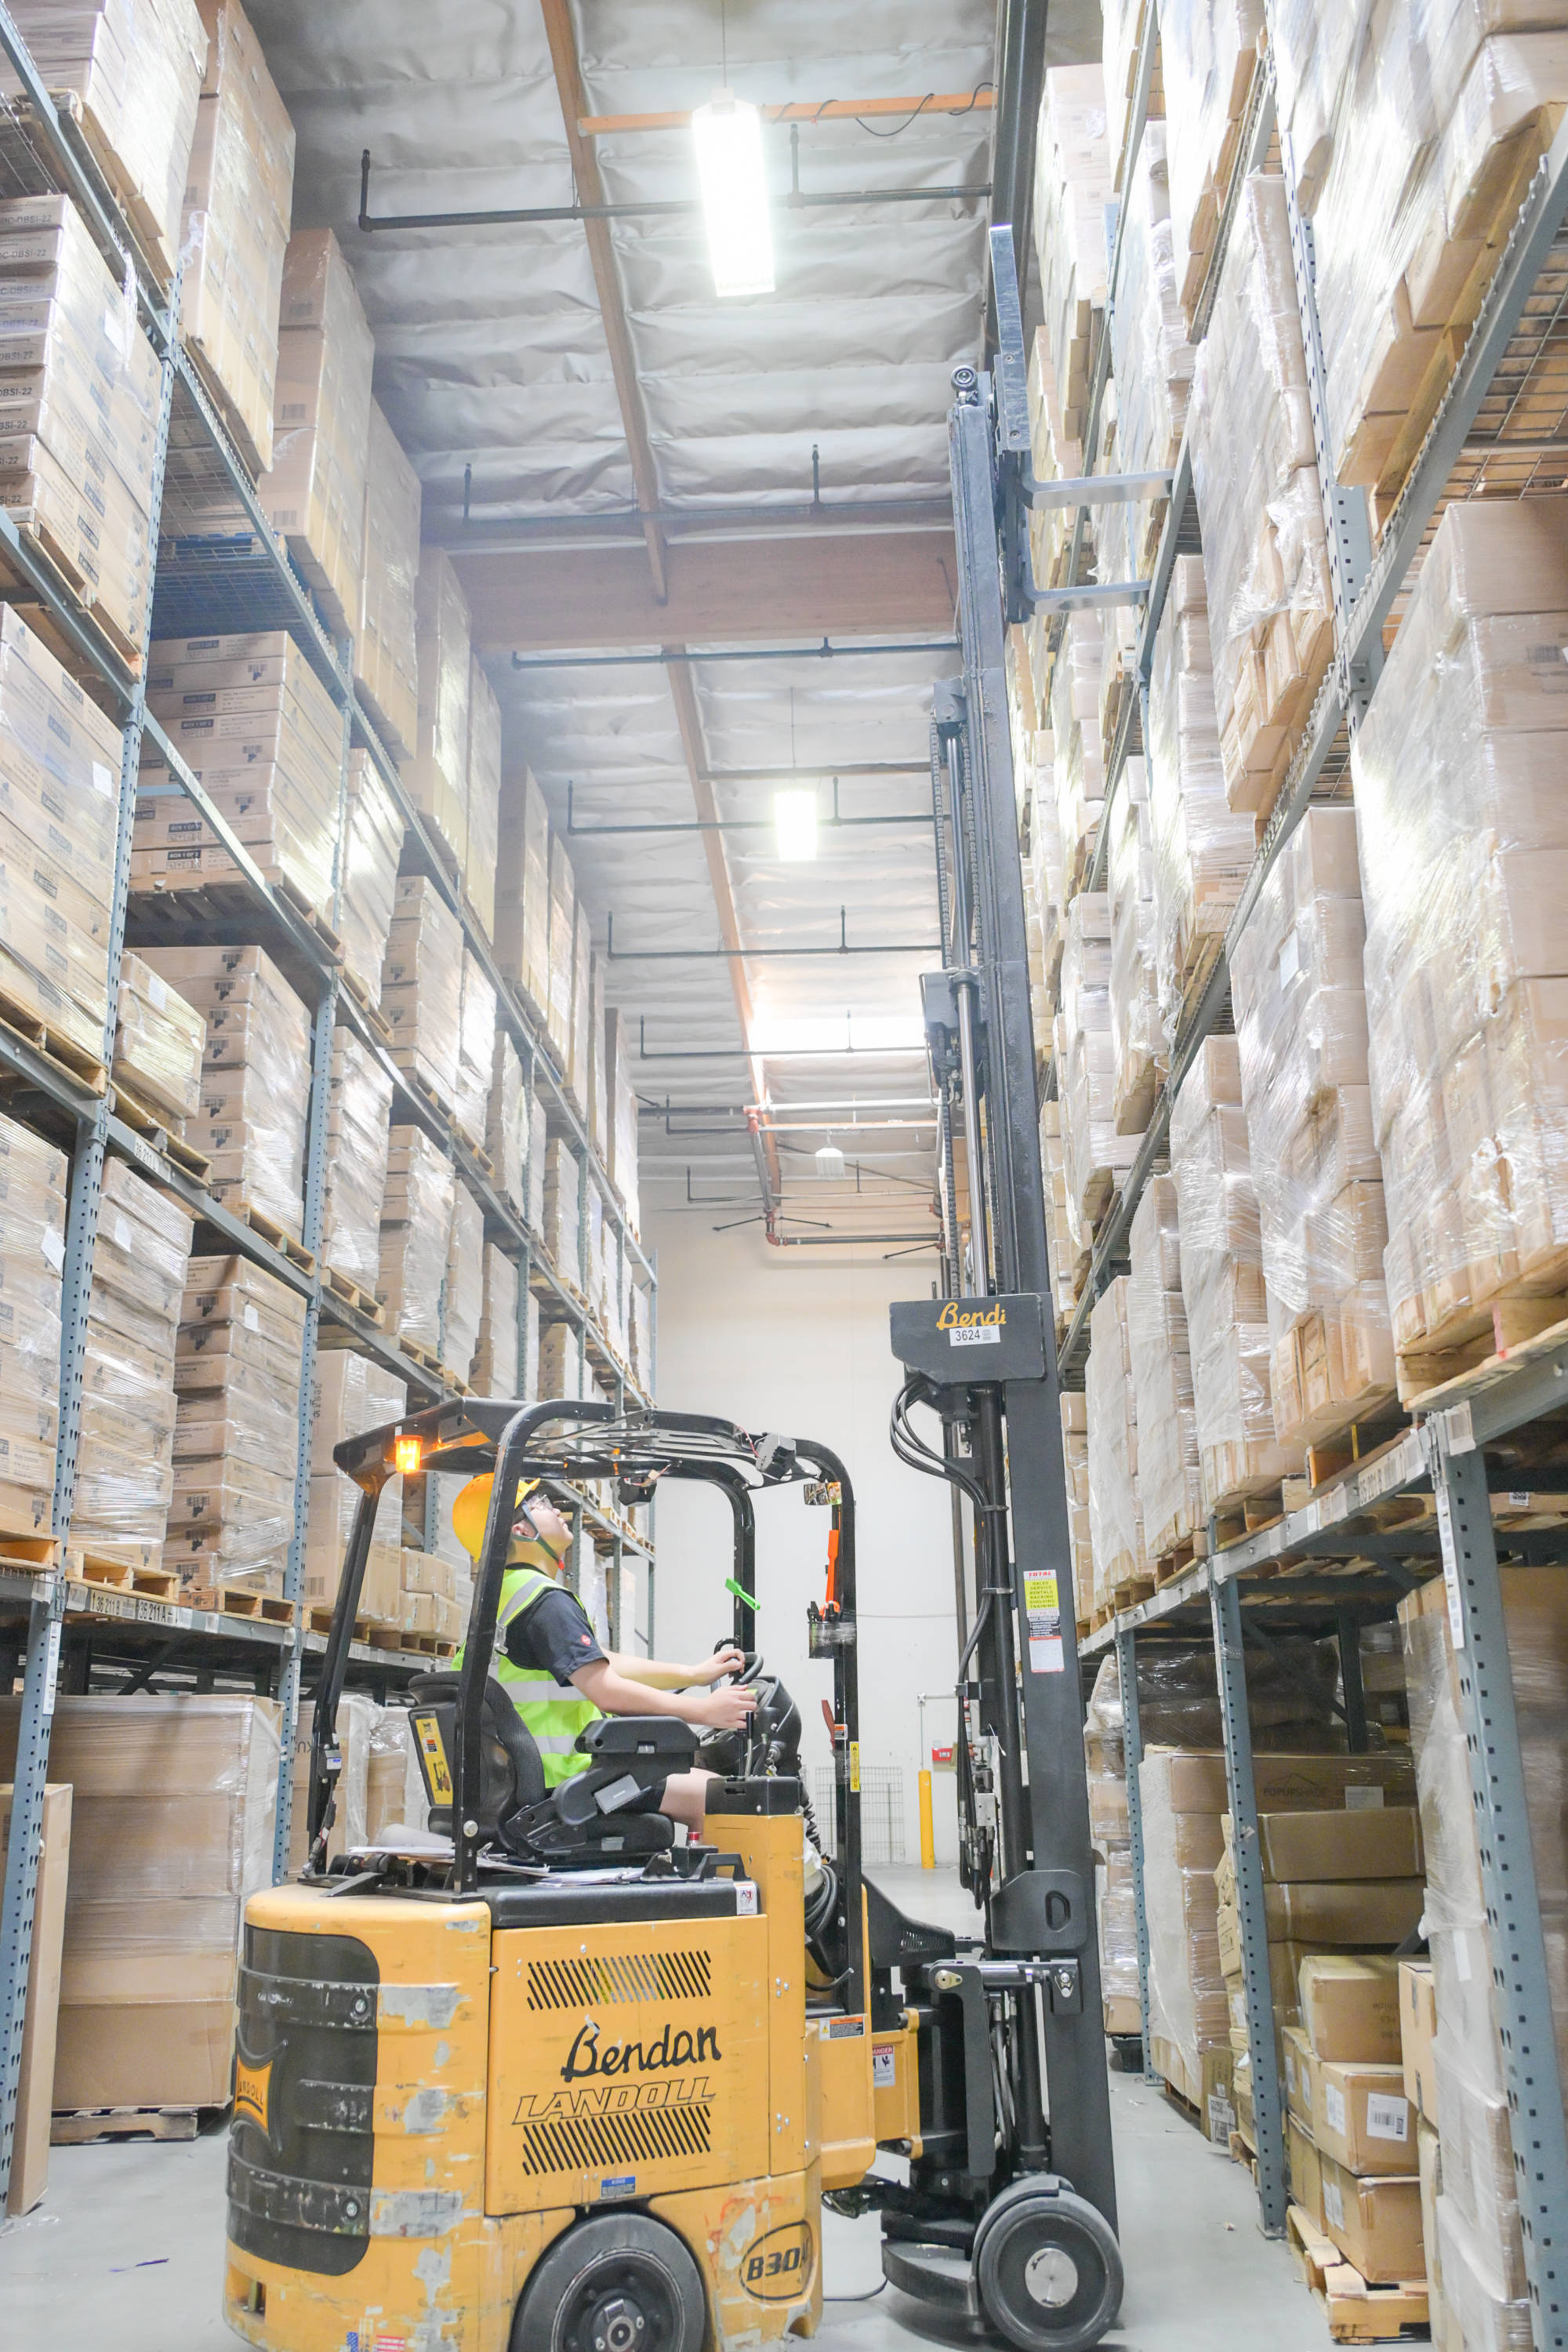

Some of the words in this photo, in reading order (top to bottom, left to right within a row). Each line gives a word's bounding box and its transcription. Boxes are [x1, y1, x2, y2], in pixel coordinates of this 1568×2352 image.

[936, 1301, 1006, 1330] Bendi
[955, 1329, 981, 1341] 3624
[96, 1596, 104, 1613] 36
[104, 1598, 115, 1615] 211
[149, 1603, 160, 1621] 211
[560, 2015, 723, 2082] Bendan
[873, 2046, 893, 2056] ANGER
[512, 2075, 717, 2126] LANDOLL
